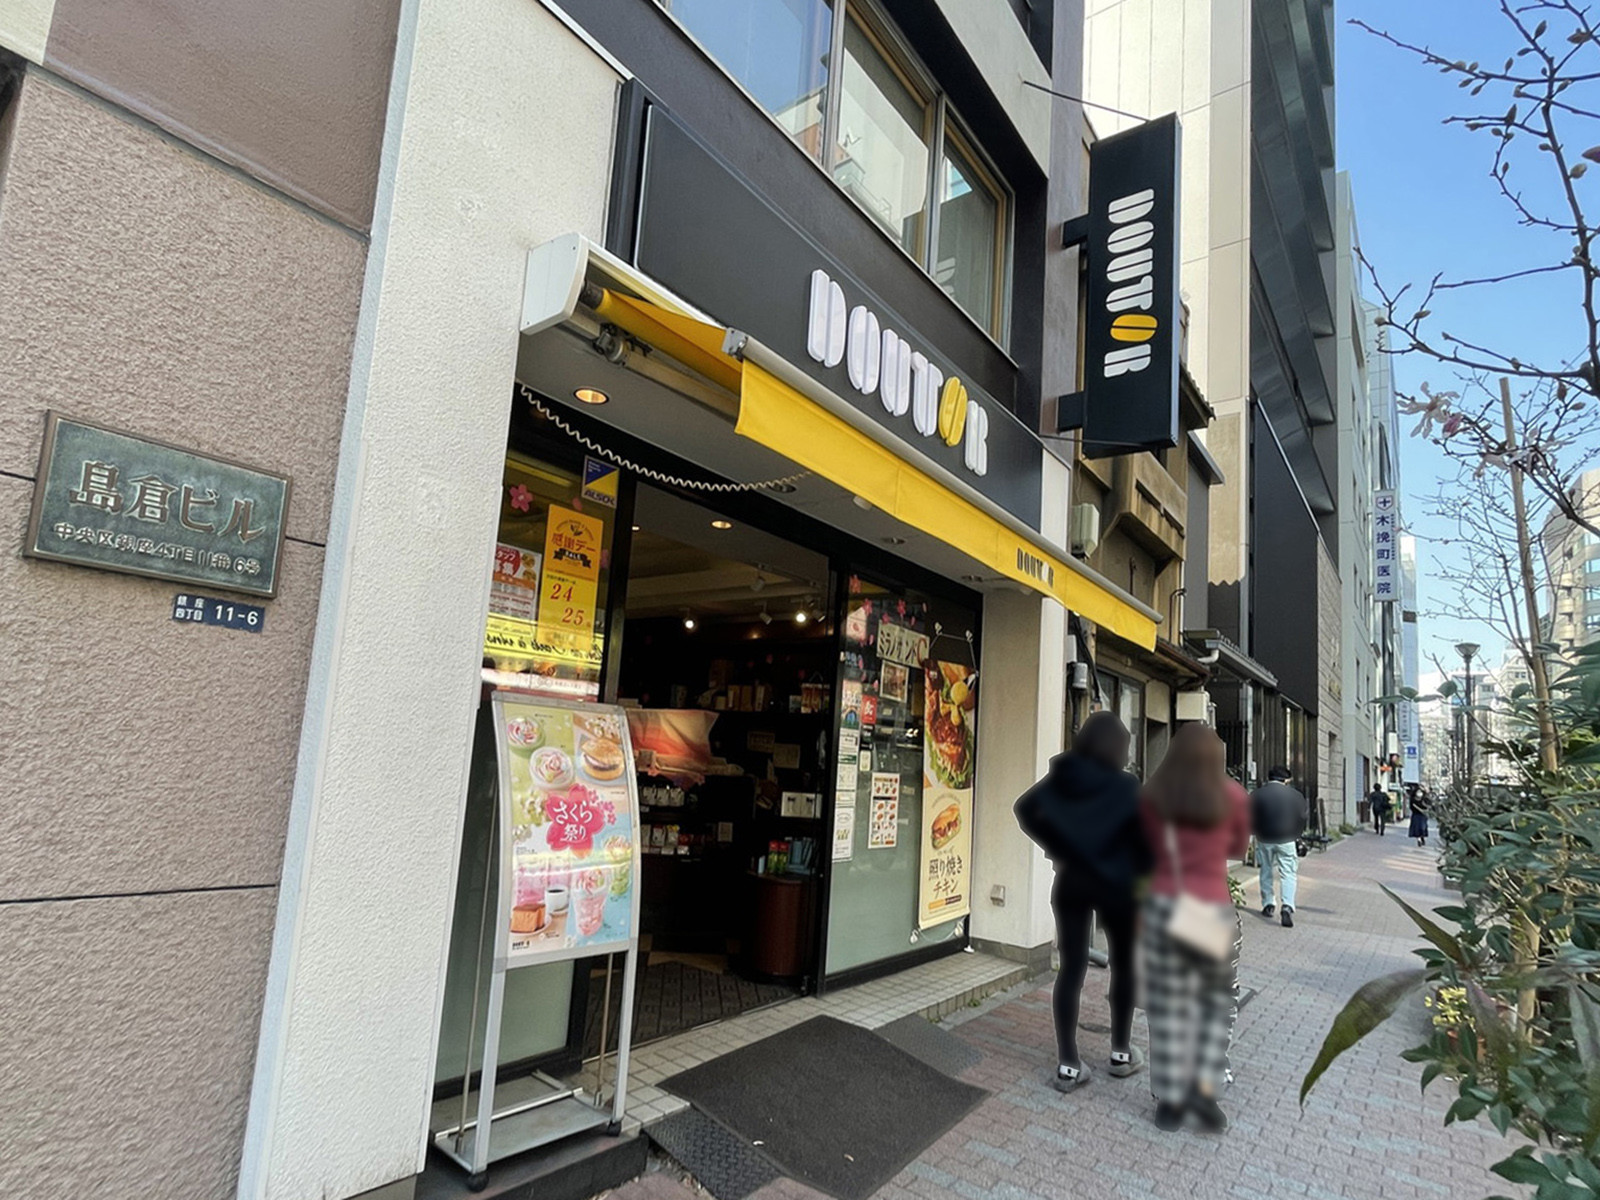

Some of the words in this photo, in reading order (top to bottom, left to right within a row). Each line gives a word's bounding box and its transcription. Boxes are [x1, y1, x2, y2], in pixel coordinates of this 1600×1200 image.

[1104, 188, 1158, 378] DOUTOR
[807, 269, 989, 477] DOUTOR
[69, 460, 266, 544] 島倉ビル
[1376, 514, 1391, 594] 木挽町医院
[1017, 548, 1054, 588] DOUTOR
[550, 583, 573, 602] 24
[215, 605, 259, 625] 11-6
[561, 607, 585, 626] 25
[553, 800, 593, 825] さくら
[561, 824, 586, 841] 祭り
[933, 878, 958, 899] チキン
